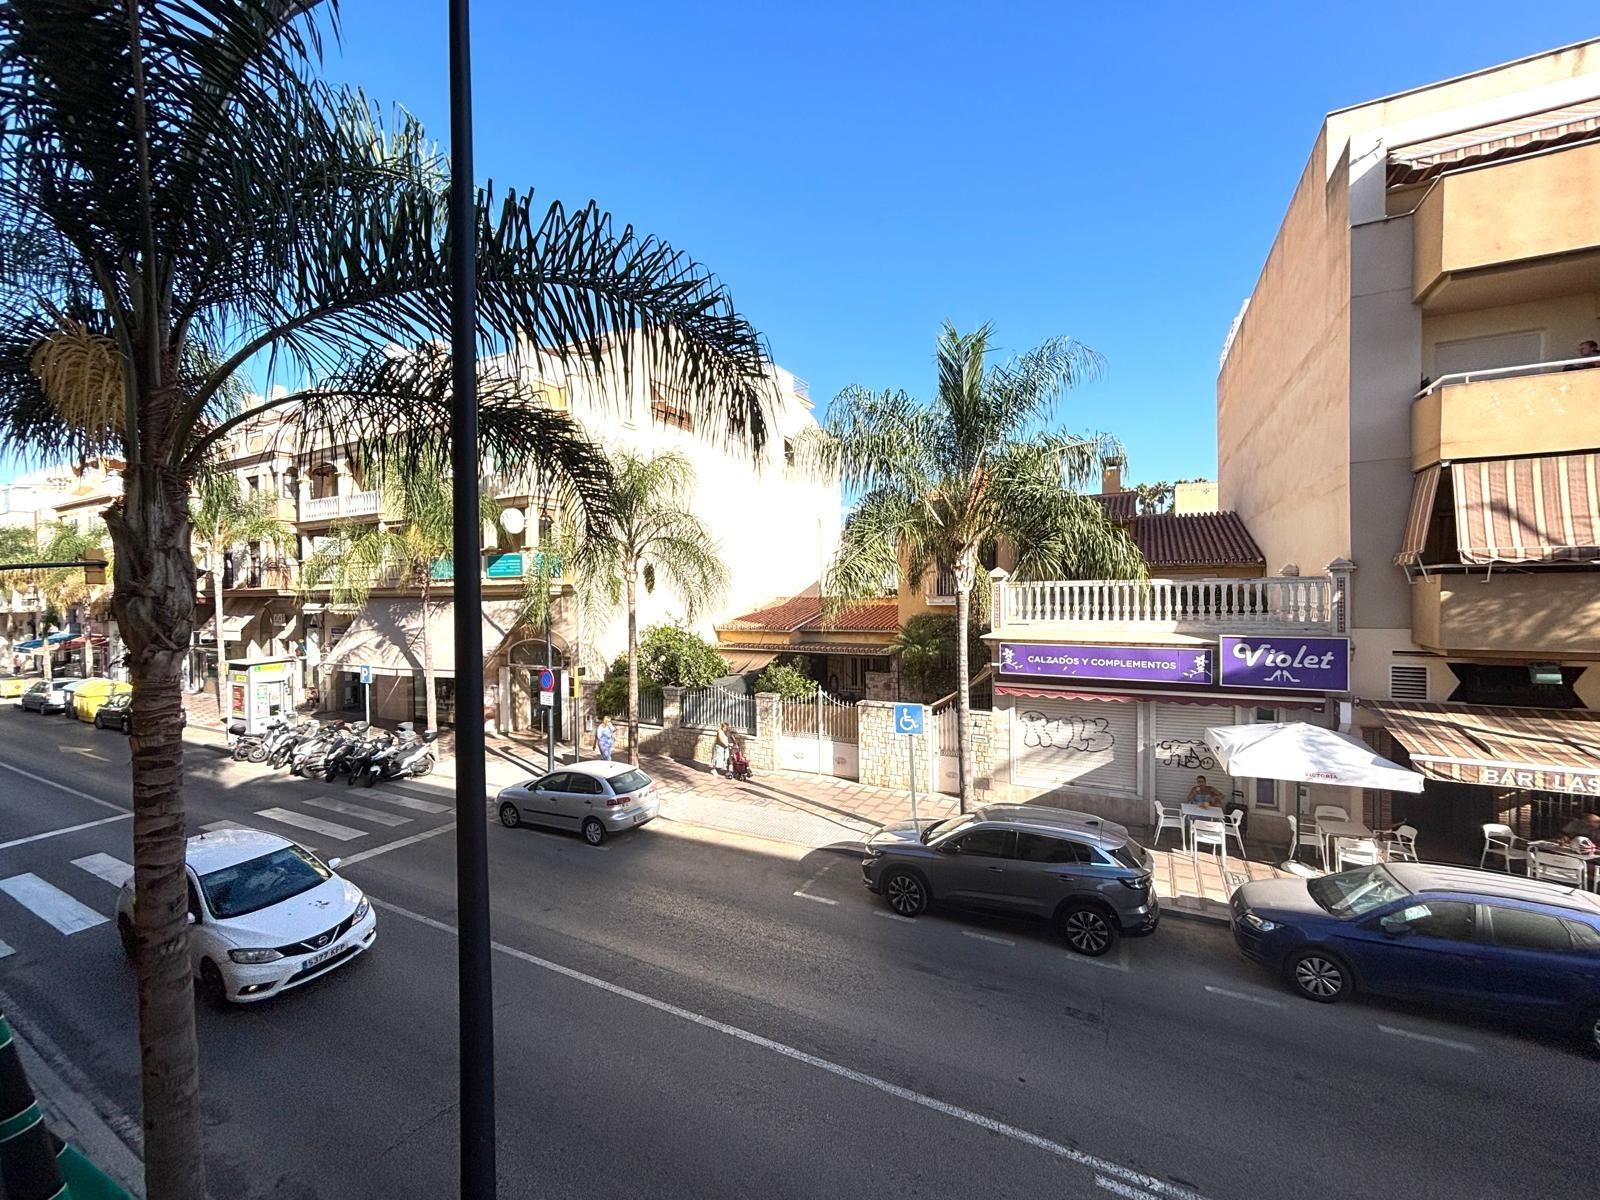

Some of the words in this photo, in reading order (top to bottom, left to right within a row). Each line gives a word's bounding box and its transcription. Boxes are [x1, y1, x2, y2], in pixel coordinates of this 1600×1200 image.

[1027, 655, 1079, 665] CALZADOS
[1090, 658, 1177, 670] COMPLEMENTOS
[1233, 643, 1335, 669] Violet
[361, 667, 369, 682] P
[1484, 768, 1535, 789] BAR
